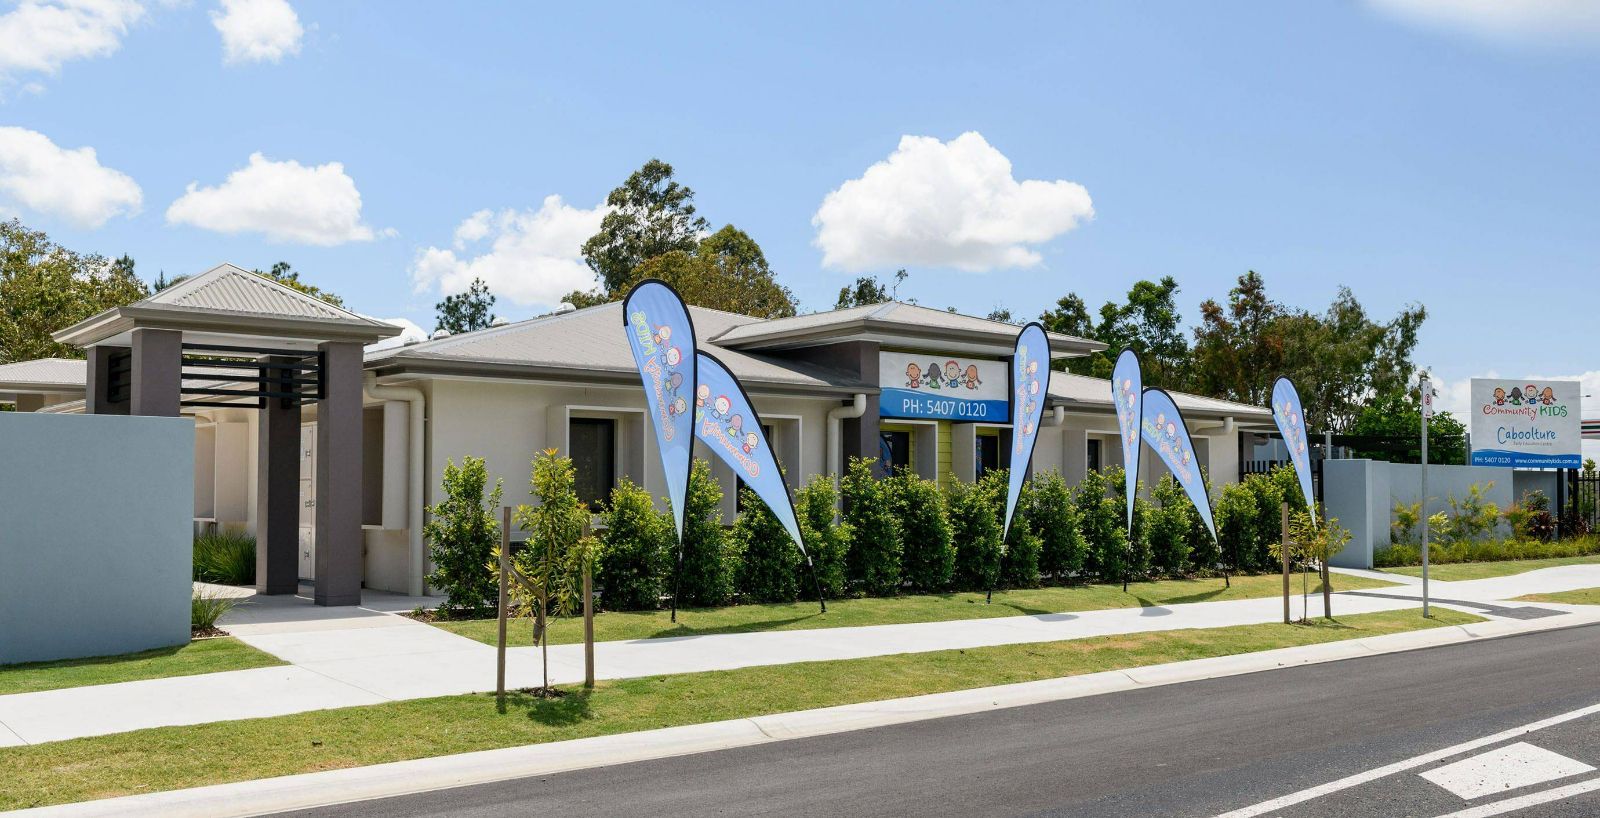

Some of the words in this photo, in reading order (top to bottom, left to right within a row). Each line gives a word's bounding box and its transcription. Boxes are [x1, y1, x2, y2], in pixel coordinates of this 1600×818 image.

[903, 399, 923, 414] PH:
[927, 400, 955, 415] 5407
[958, 401, 987, 417] 0120
[1482, 404, 1538, 422] Community
[1539, 405, 1568, 417] KIDS
[1497, 426, 1556, 444] Caboolture
